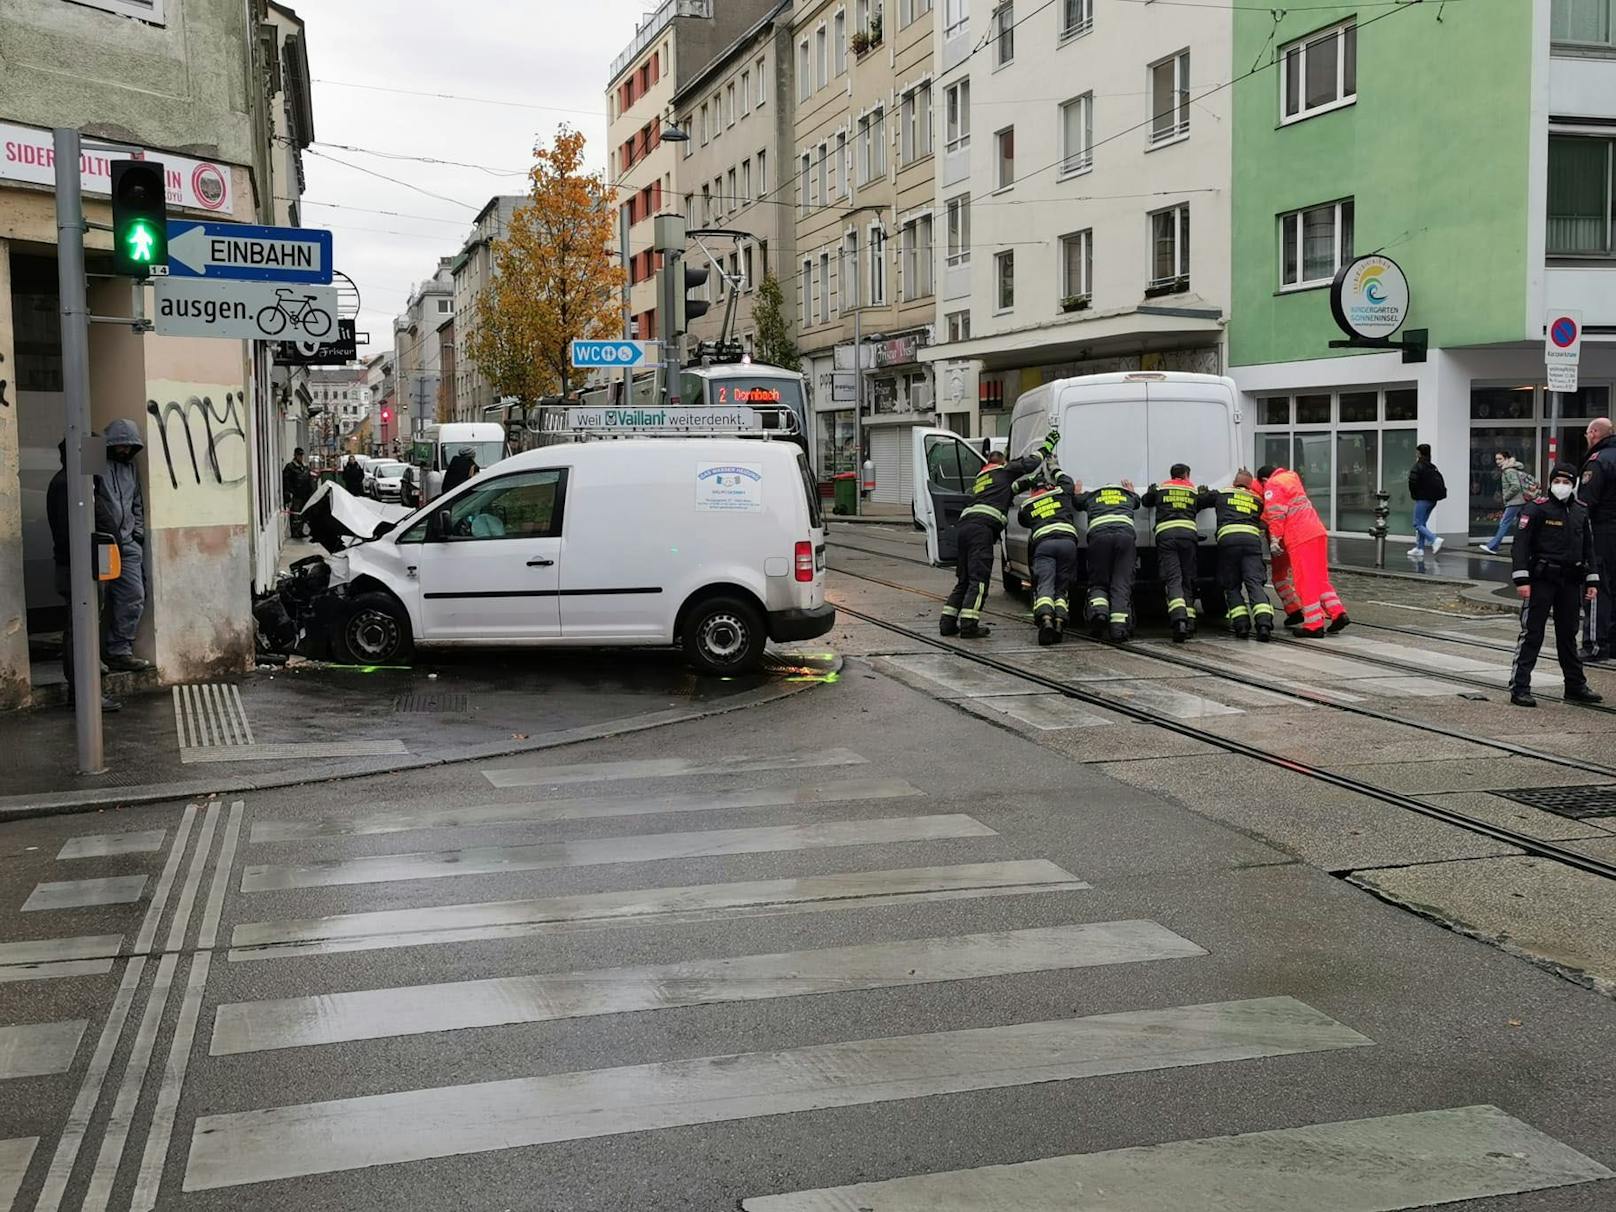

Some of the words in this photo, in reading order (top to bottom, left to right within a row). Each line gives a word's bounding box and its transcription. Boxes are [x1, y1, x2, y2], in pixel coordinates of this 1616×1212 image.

[211, 239, 312, 267] EINBAHN
[161, 298, 253, 323] ausgen.
[576, 346, 600, 361] WC
[719, 387, 727, 403] 2
[734, 387, 780, 401] Dornbach
[577, 413, 601, 426] Weil
[617, 410, 666, 426] Vaillant
[669, 413, 745, 426] weiterdenkt.
